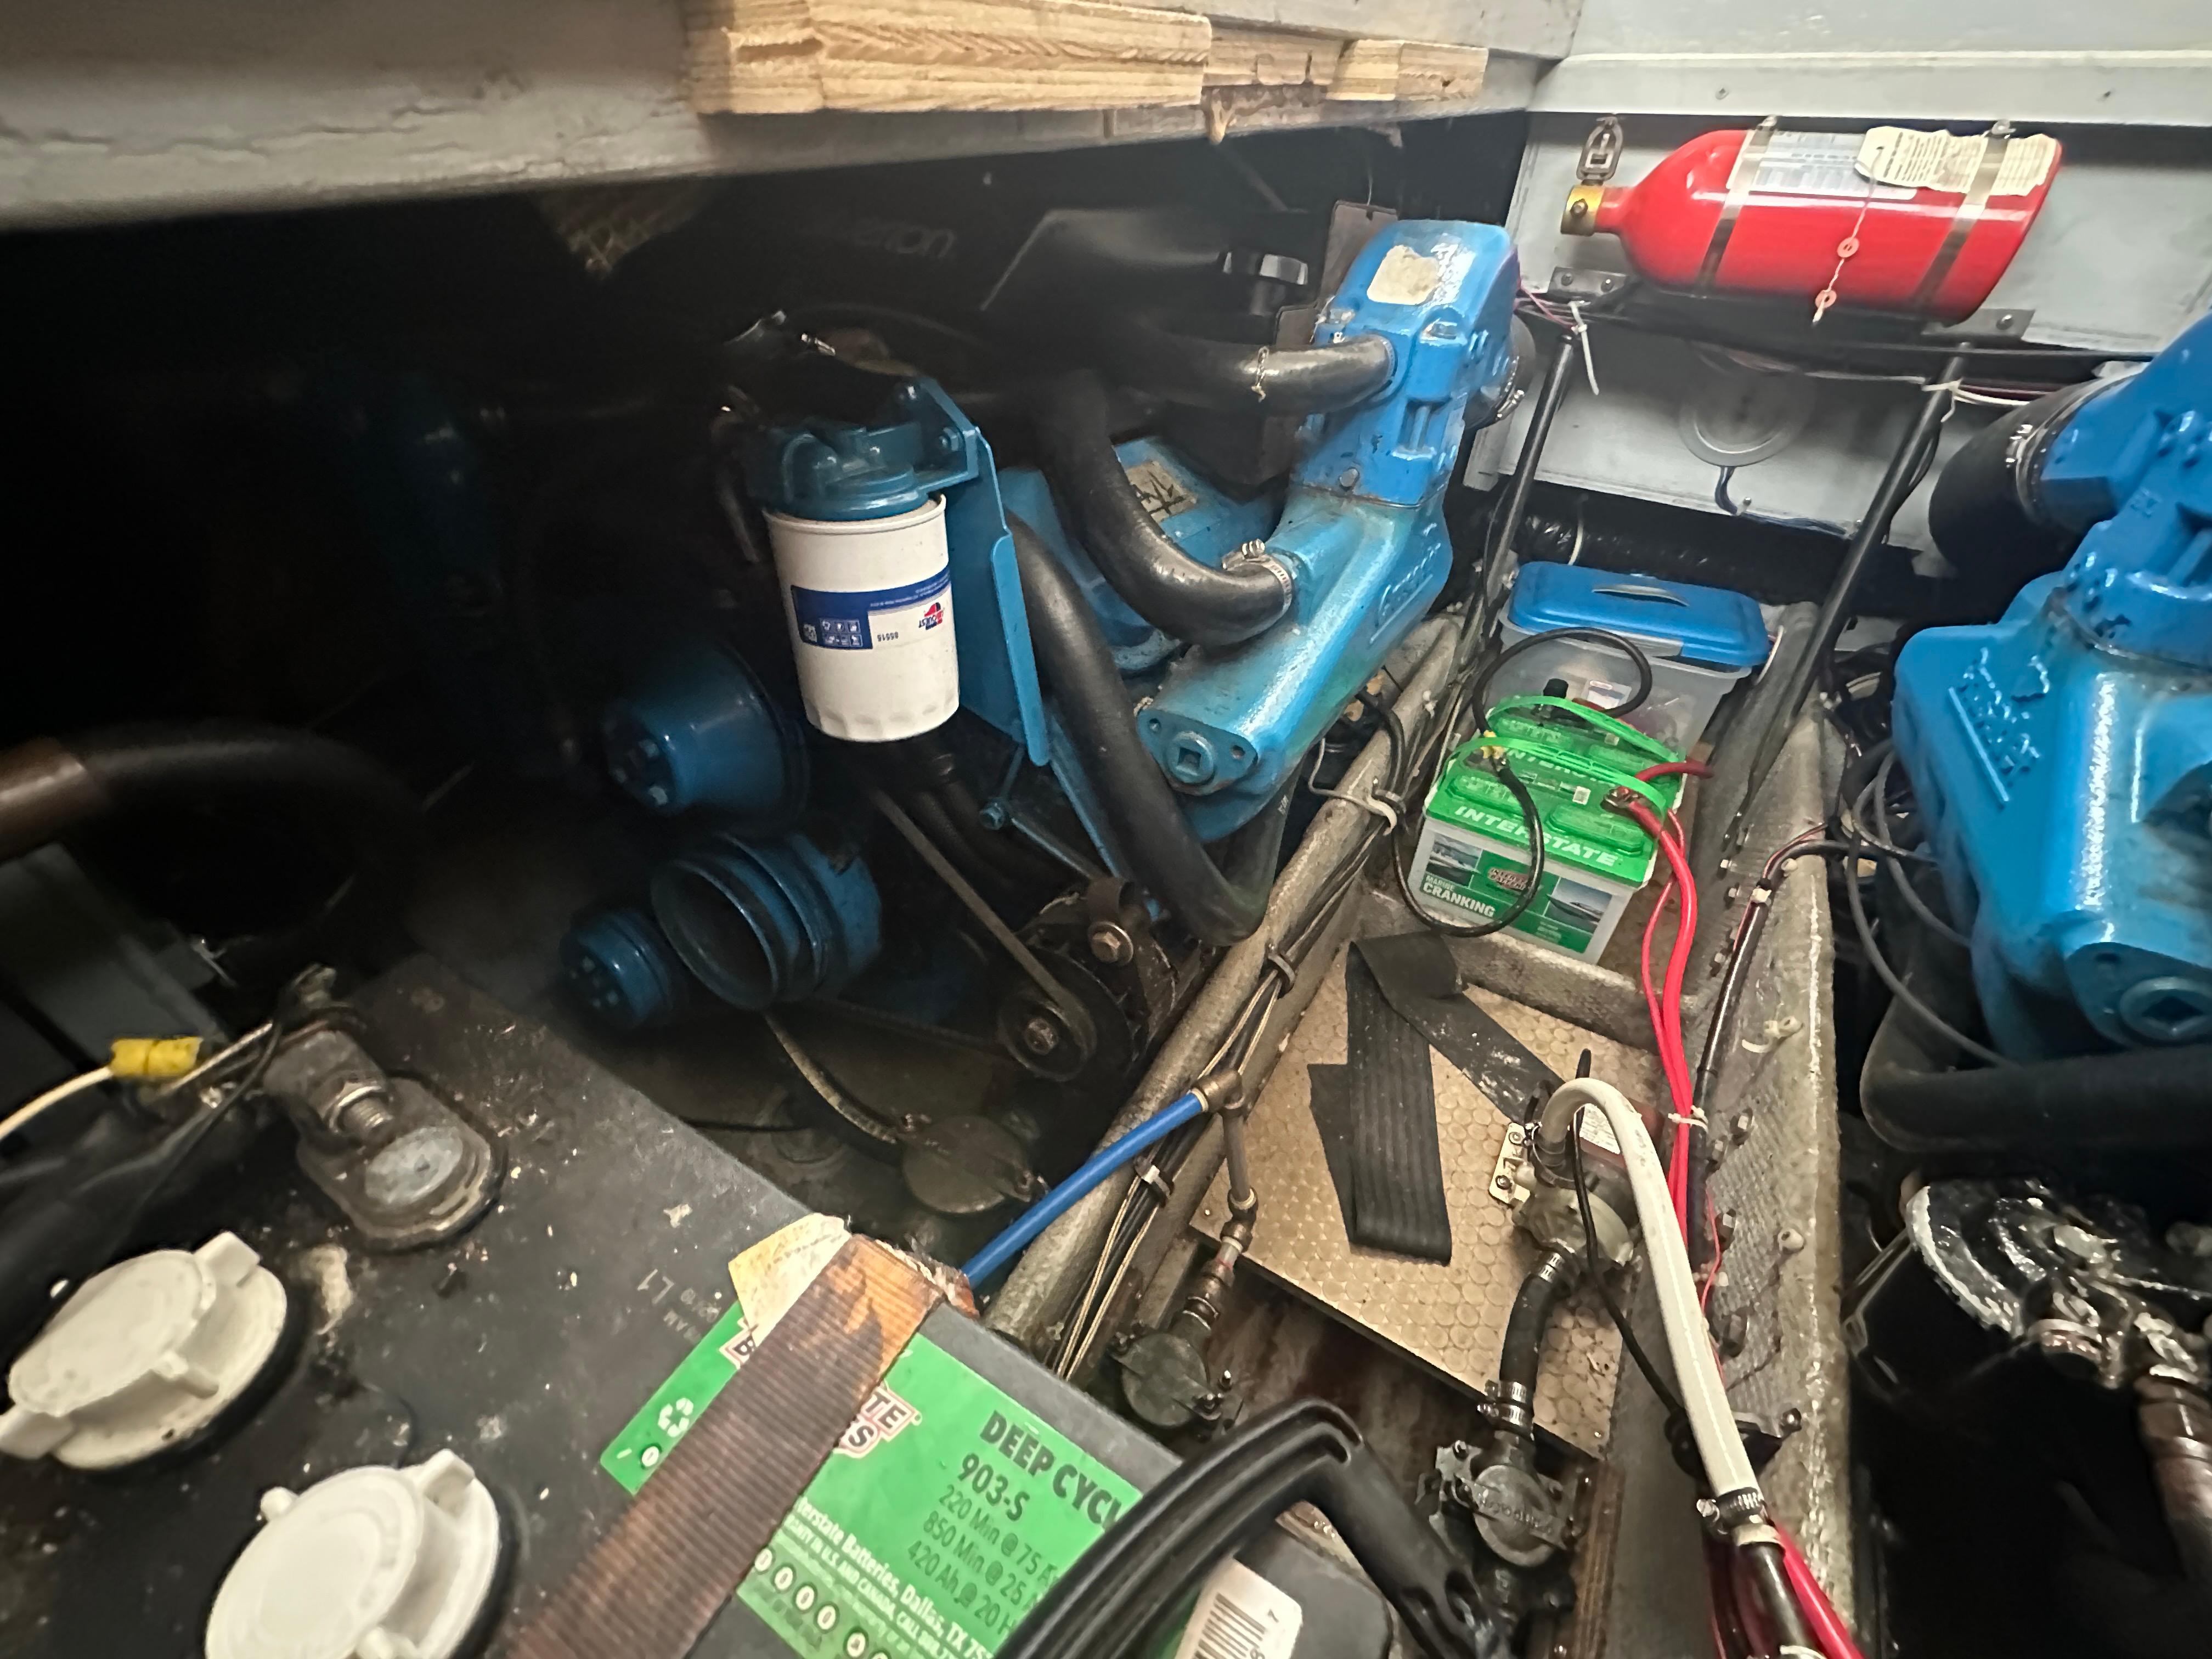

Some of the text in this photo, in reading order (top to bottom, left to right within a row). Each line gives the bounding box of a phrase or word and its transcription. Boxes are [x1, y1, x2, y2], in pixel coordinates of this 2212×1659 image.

[1423, 882, 1496, 918] CRANKING
[958, 1453, 1030, 1521] 903-S
[980, 1410, 1056, 1477] DEEP
[923, 1510, 956, 1548] 850
[953, 1534, 985, 1573] Min
[985, 1561, 1003, 1586] @
[1000, 1573, 1026, 1606] 25
[939, 1484, 972, 1520] 220
[969, 1508, 1000, 1544] Min
[1001, 1532, 1018, 1557] @
[1016, 1543, 1041, 1575] 75
[842, 1533, 900, 1599] Batteries,
[900, 1584, 945, 1638] Dallas,
[946, 1621, 969, 1652] TX
[907, 1540, 940, 1577] 420
[934, 1564, 959, 1594] Ah
[974, 1594, 1001, 1628] 20
